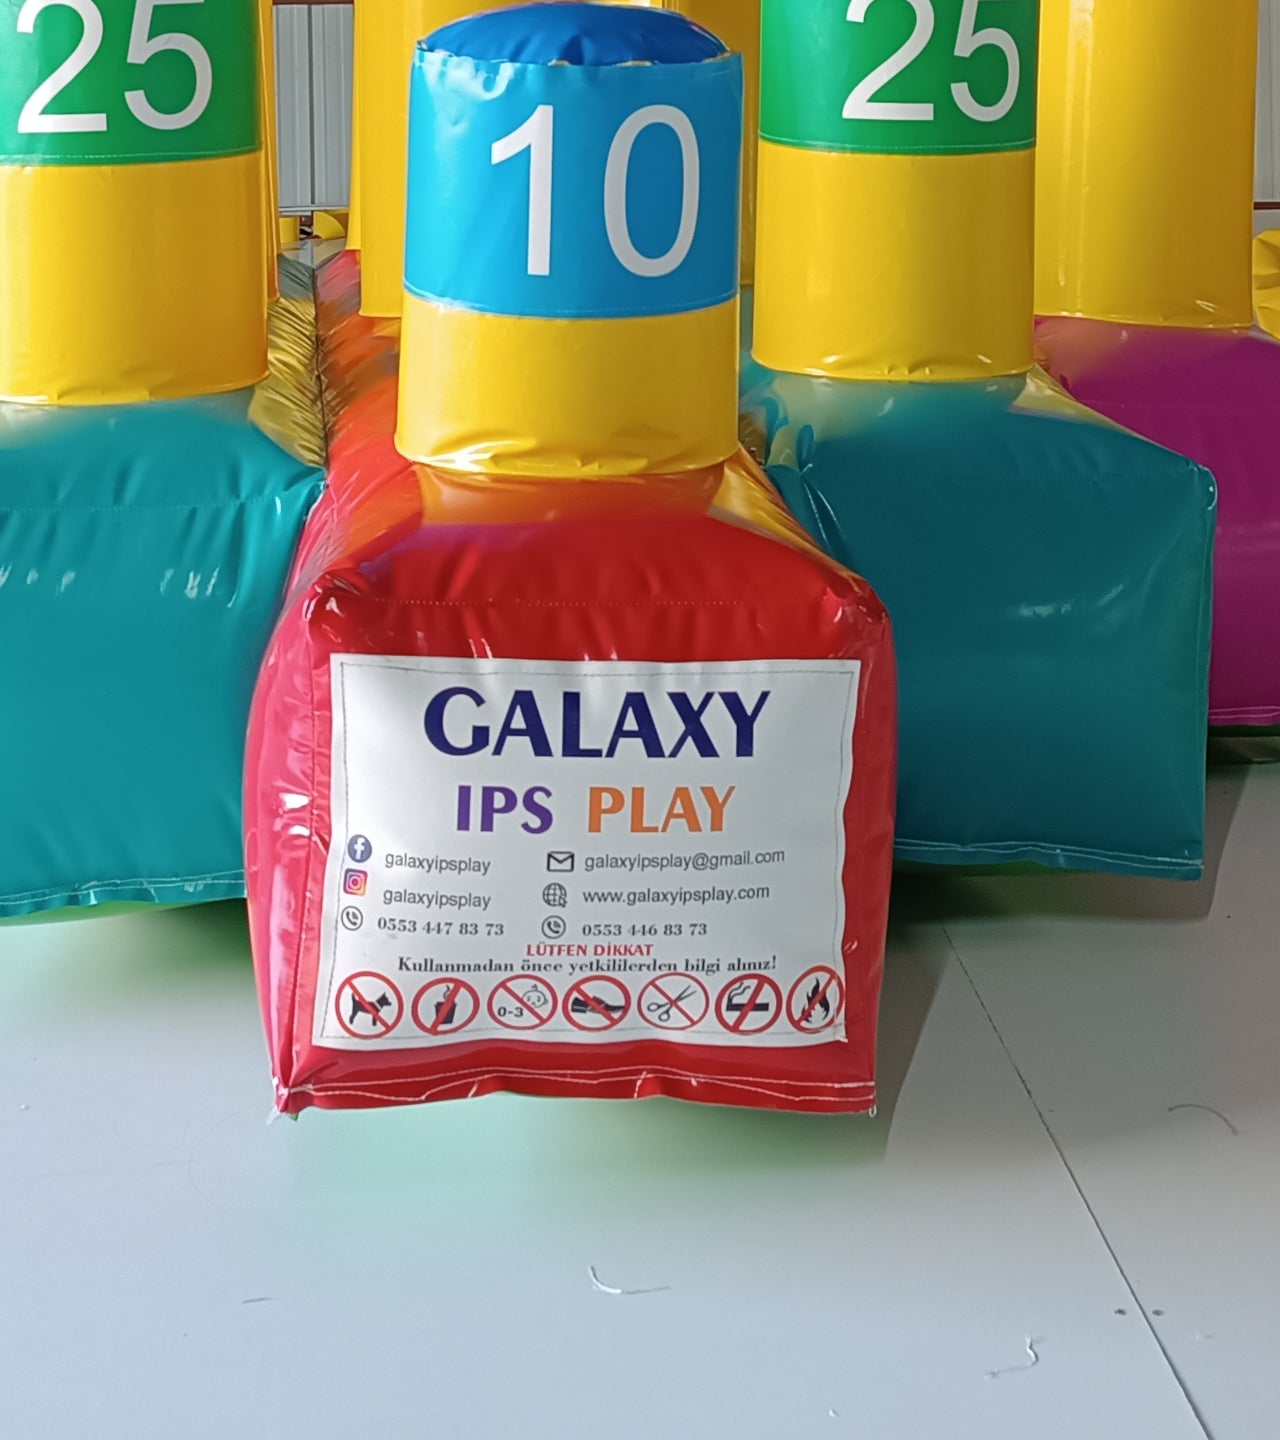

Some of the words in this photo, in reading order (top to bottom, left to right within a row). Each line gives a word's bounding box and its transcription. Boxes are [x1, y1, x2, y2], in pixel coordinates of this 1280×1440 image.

[490, 105, 700, 278] 10
[424, 686, 770, 758] GALAXY
[456, 785, 553, 834] IPS
[587, 786, 735, 833] PLAY
[385, 853, 491, 876] galaxyipsplay
[584, 849, 785, 872] galaxyipsplay@gmail.com
[383, 889, 491, 911] galaxyipsplay
[582, 885, 770, 906] www.galaxyipsplay.com
[377, 917, 417, 933] 0553
[422, 921, 453, 934] 447
[458, 923, 479, 936] 83
[485, 923, 504, 936] 73
[582, 924, 622, 936] 0553
[627, 924, 658, 936] 446
[663, 924, 683, 936] 83
[689, 923, 708, 936] 73
[526, 941, 587, 956] LÜTFEN
[593, 940, 654, 956] DİKKAT
[398, 957, 514, 972] Kullanmadan
[521, 959, 563, 972] önce
[568, 958, 678, 976] yetkililerden
[684, 958, 720, 976] bilgi
